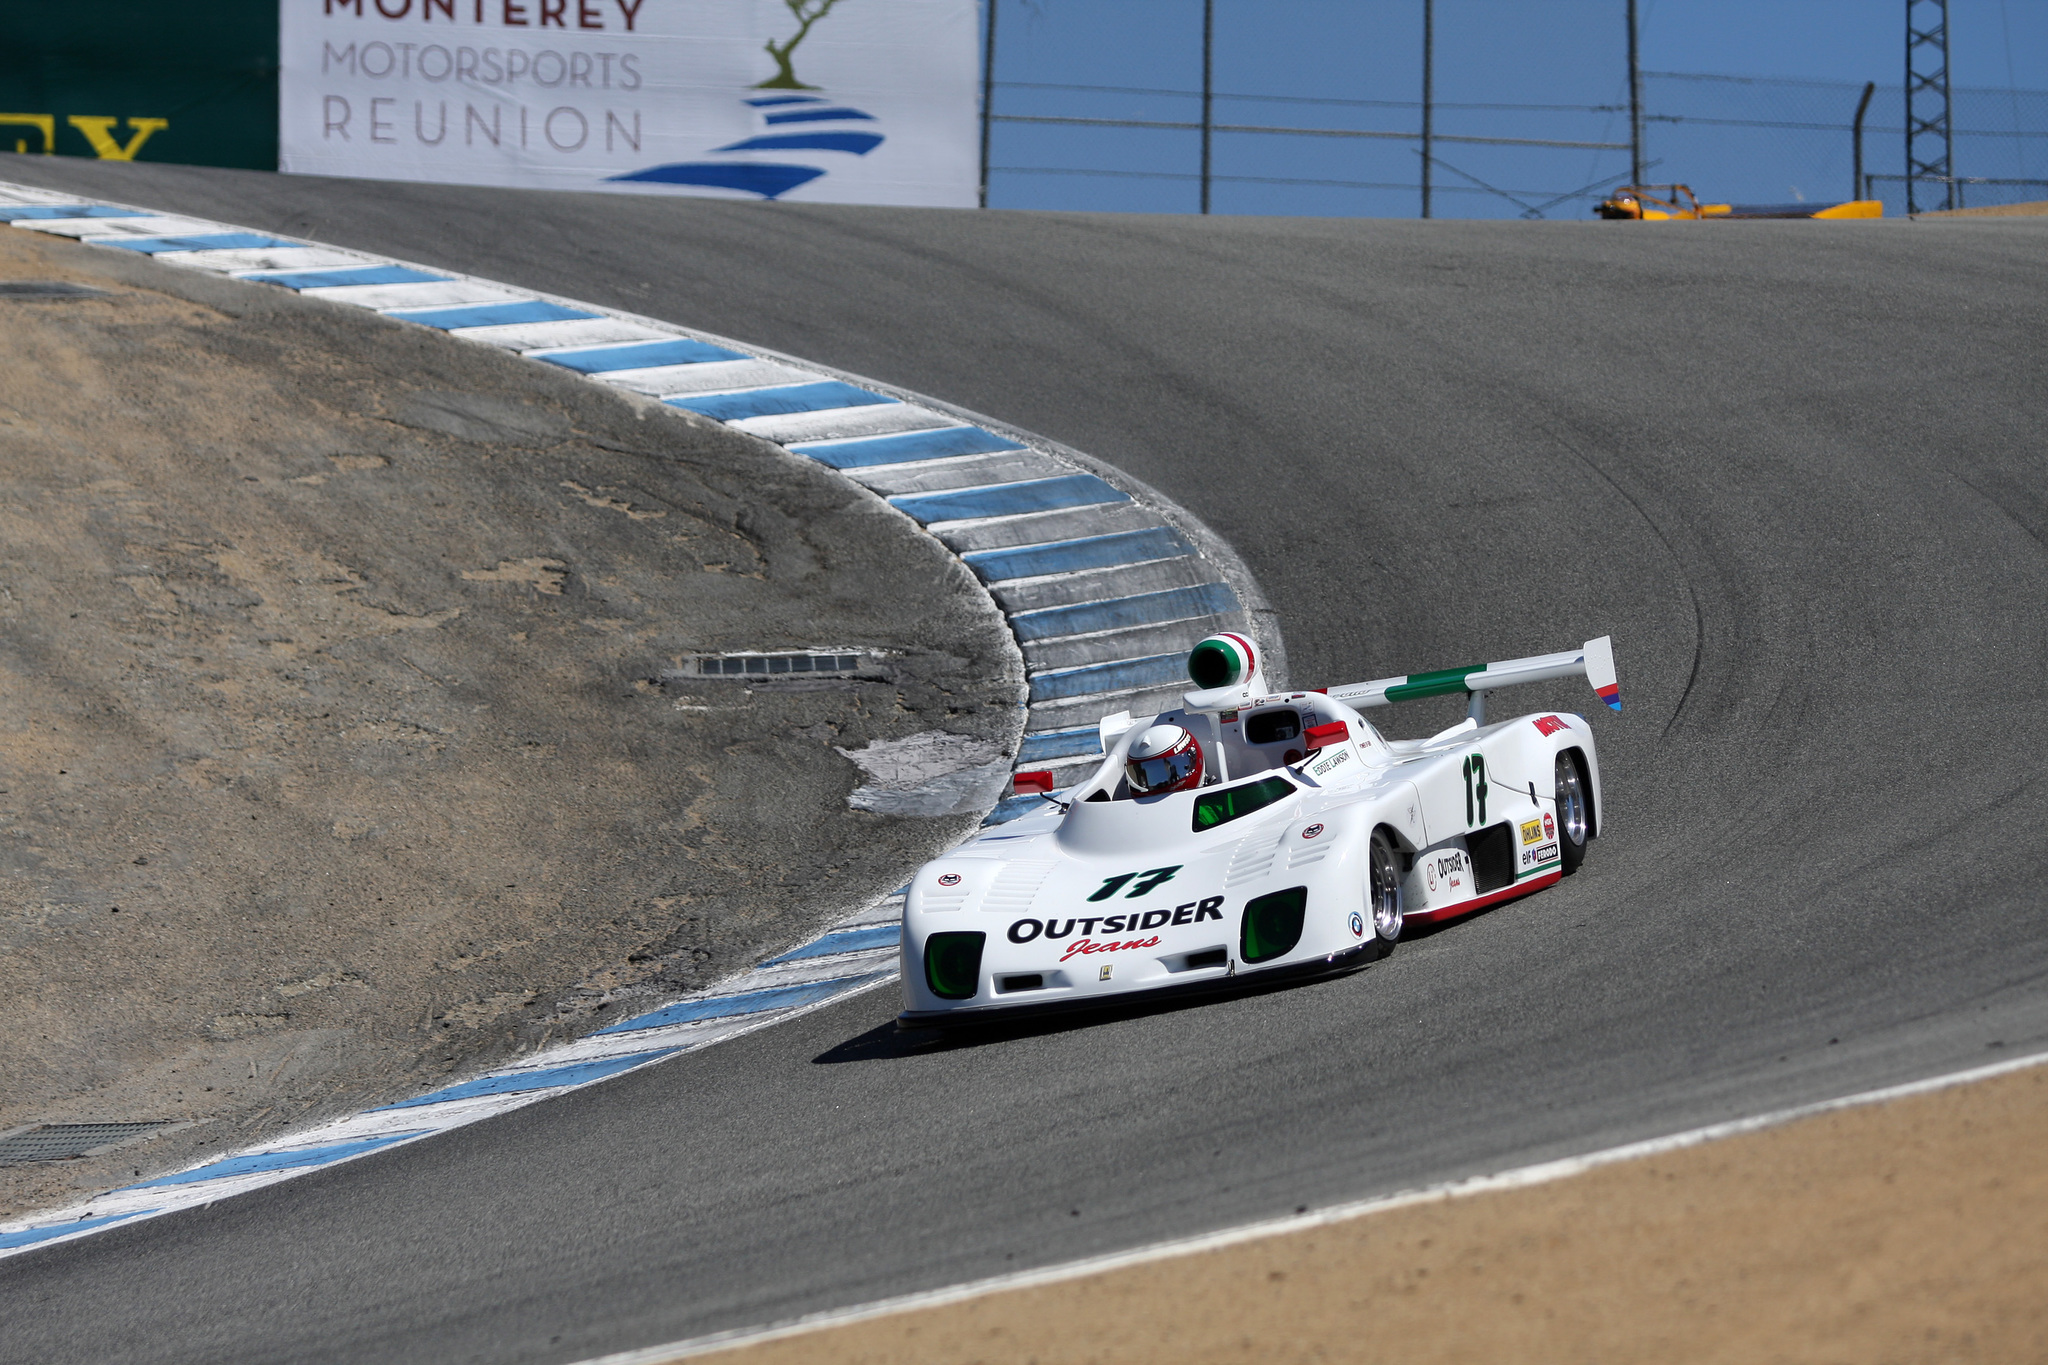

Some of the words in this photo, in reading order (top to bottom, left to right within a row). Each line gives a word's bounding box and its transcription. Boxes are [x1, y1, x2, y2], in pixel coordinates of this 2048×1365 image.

[321, 40, 643, 92] MOTORSPORTS
[322, 94, 642, 153] REUNION
[1462, 752, 1488, 828] 17
[1086, 864, 1184, 902] 17
[1438, 851, 1465, 879] OUTSIDER
[1006, 895, 1226, 944] OUTSIDER
[1059, 935, 1162, 963] Jeans
